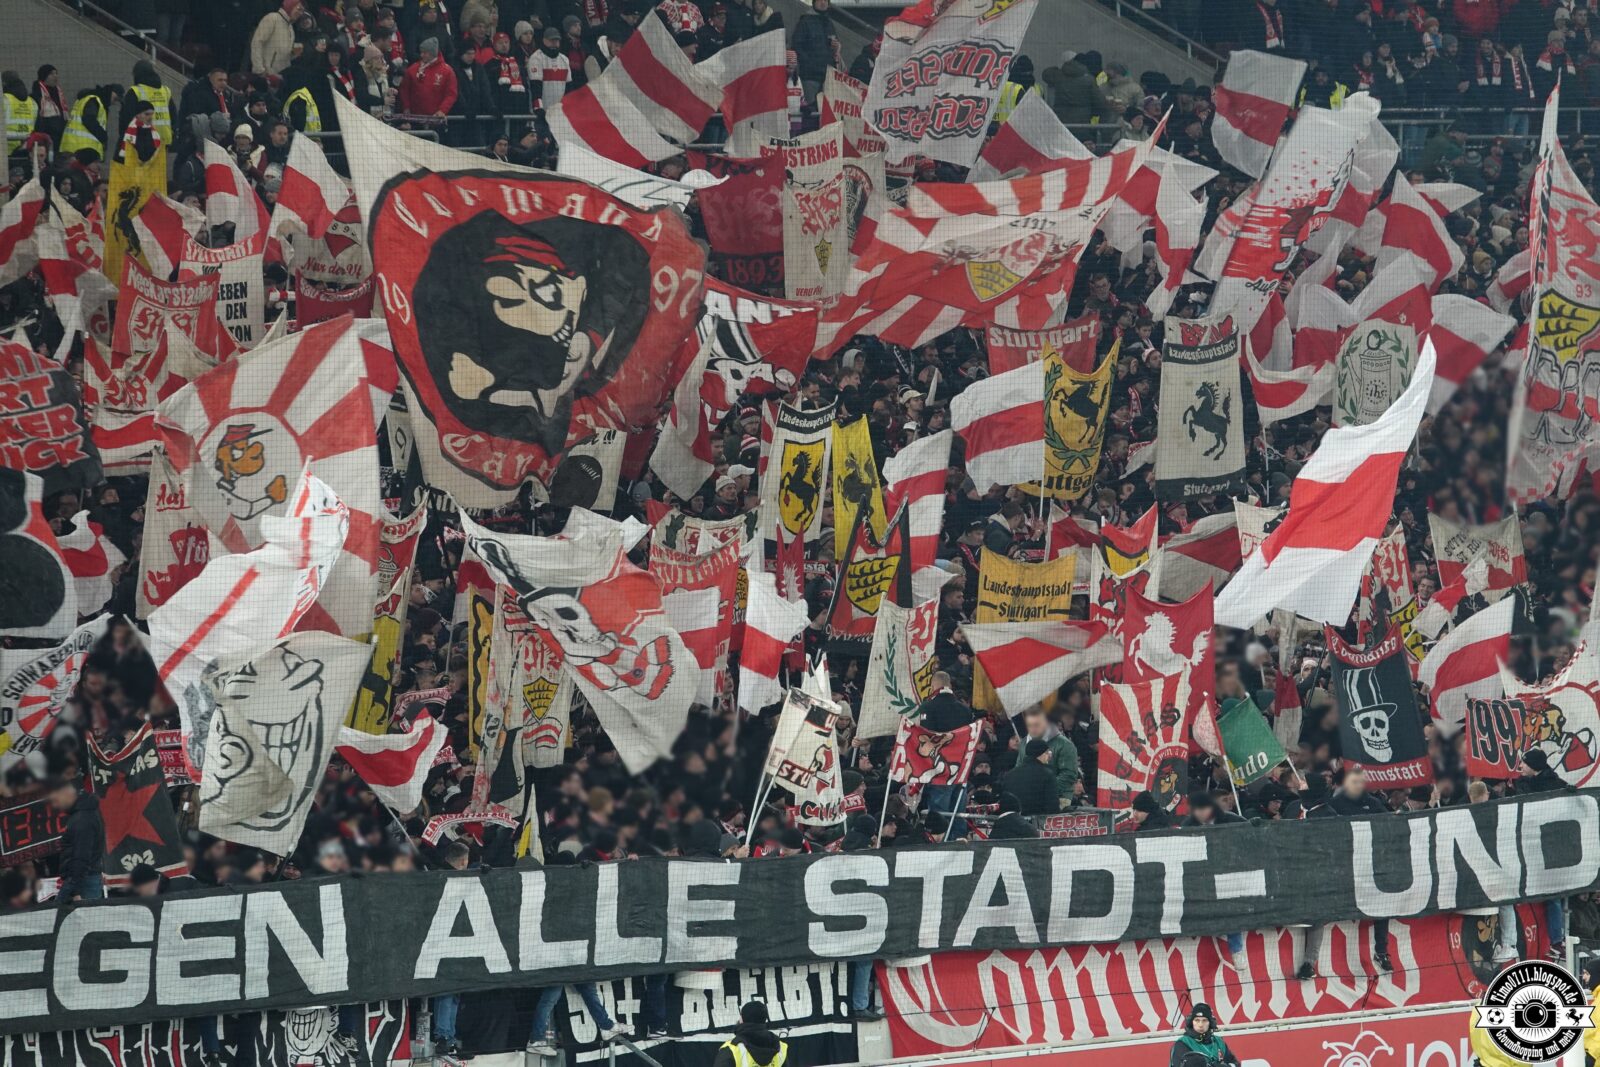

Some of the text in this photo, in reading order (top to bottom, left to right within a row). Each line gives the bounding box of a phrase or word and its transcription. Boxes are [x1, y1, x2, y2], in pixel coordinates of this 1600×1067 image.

[833, 100, 862, 118] MEIN
[217, 282, 248, 300] EBEN
[653, 264, 704, 320] 97
[1575, 284, 1593, 298] 93
[226, 302, 247, 320] DEN
[989, 319, 1098, 349] Stuttgart
[983, 575, 1072, 599] Landeshauptstadt
[998, 602, 1048, 622] Stuttgart
[1466, 699, 1527, 772] 1997
[1044, 815, 1099, 830] JEDER
[0, 795, 1599, 1018] EGEN ALLE STADT- UND
